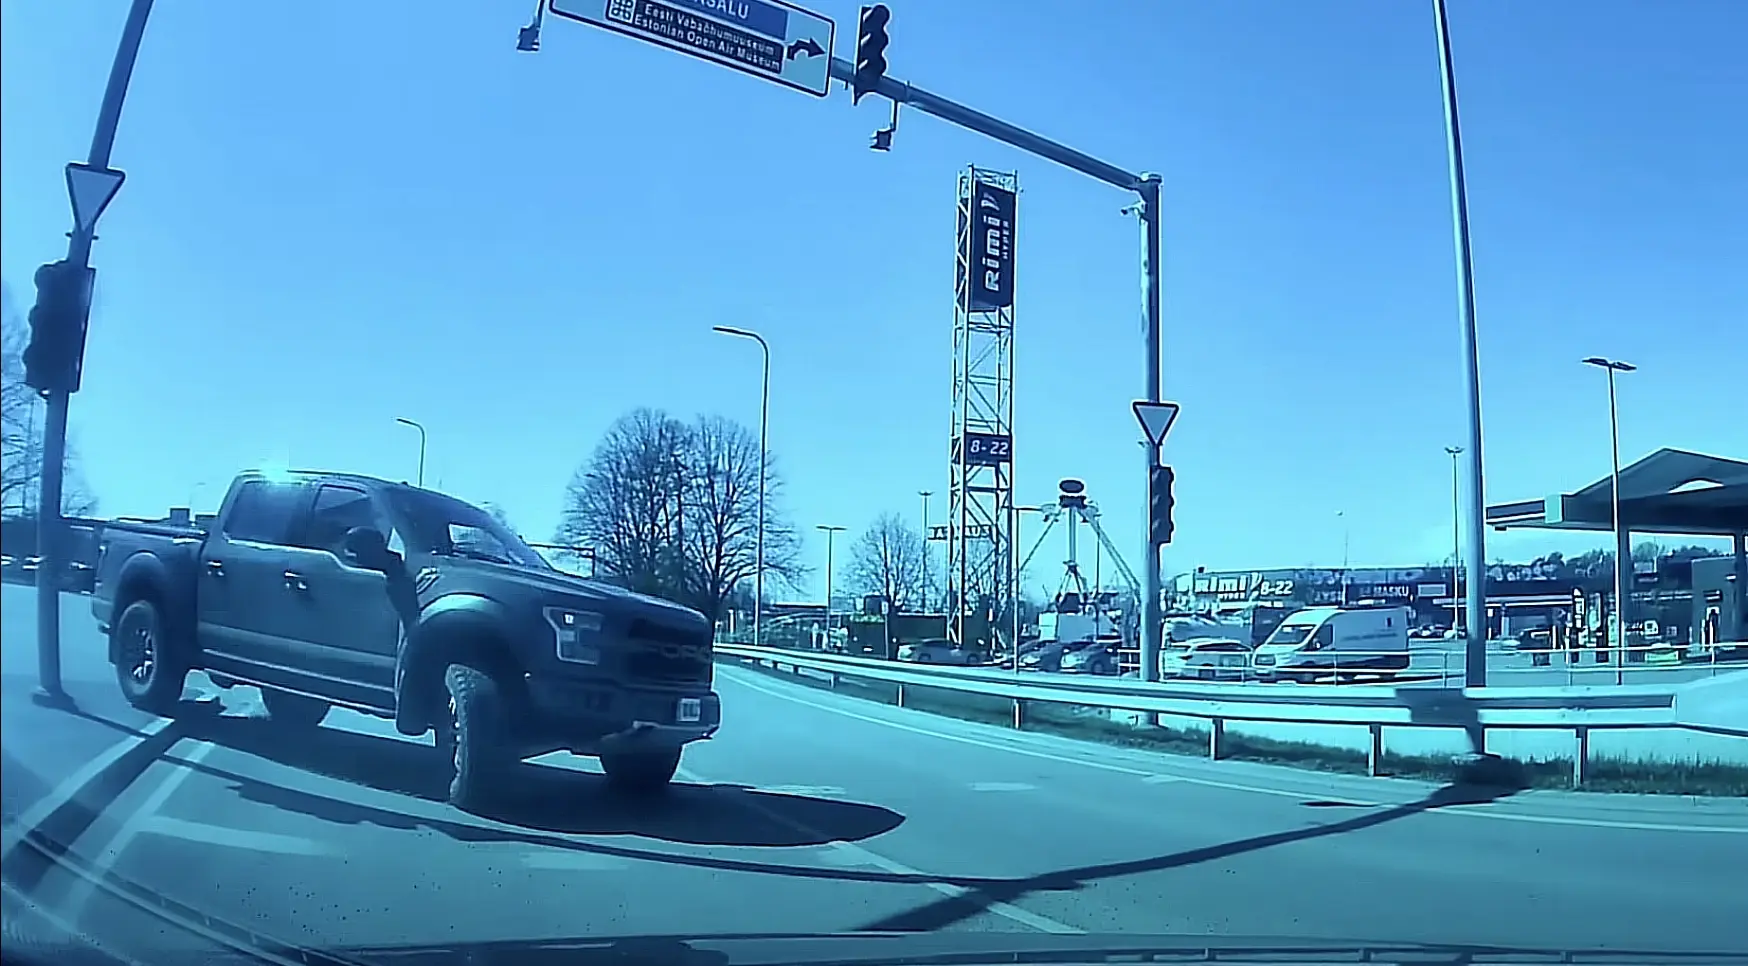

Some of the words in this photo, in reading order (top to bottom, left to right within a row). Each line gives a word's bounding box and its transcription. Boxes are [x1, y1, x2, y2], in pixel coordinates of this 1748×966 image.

[645, 4, 673, 22] Eesti
[635, 14, 684, 38] Estonian
[687, 31, 715, 49] Open
[719, 41, 735, 54] Air
[738, 46, 780, 72] Museum
[1260, 580, 1294, 595] 8-22
